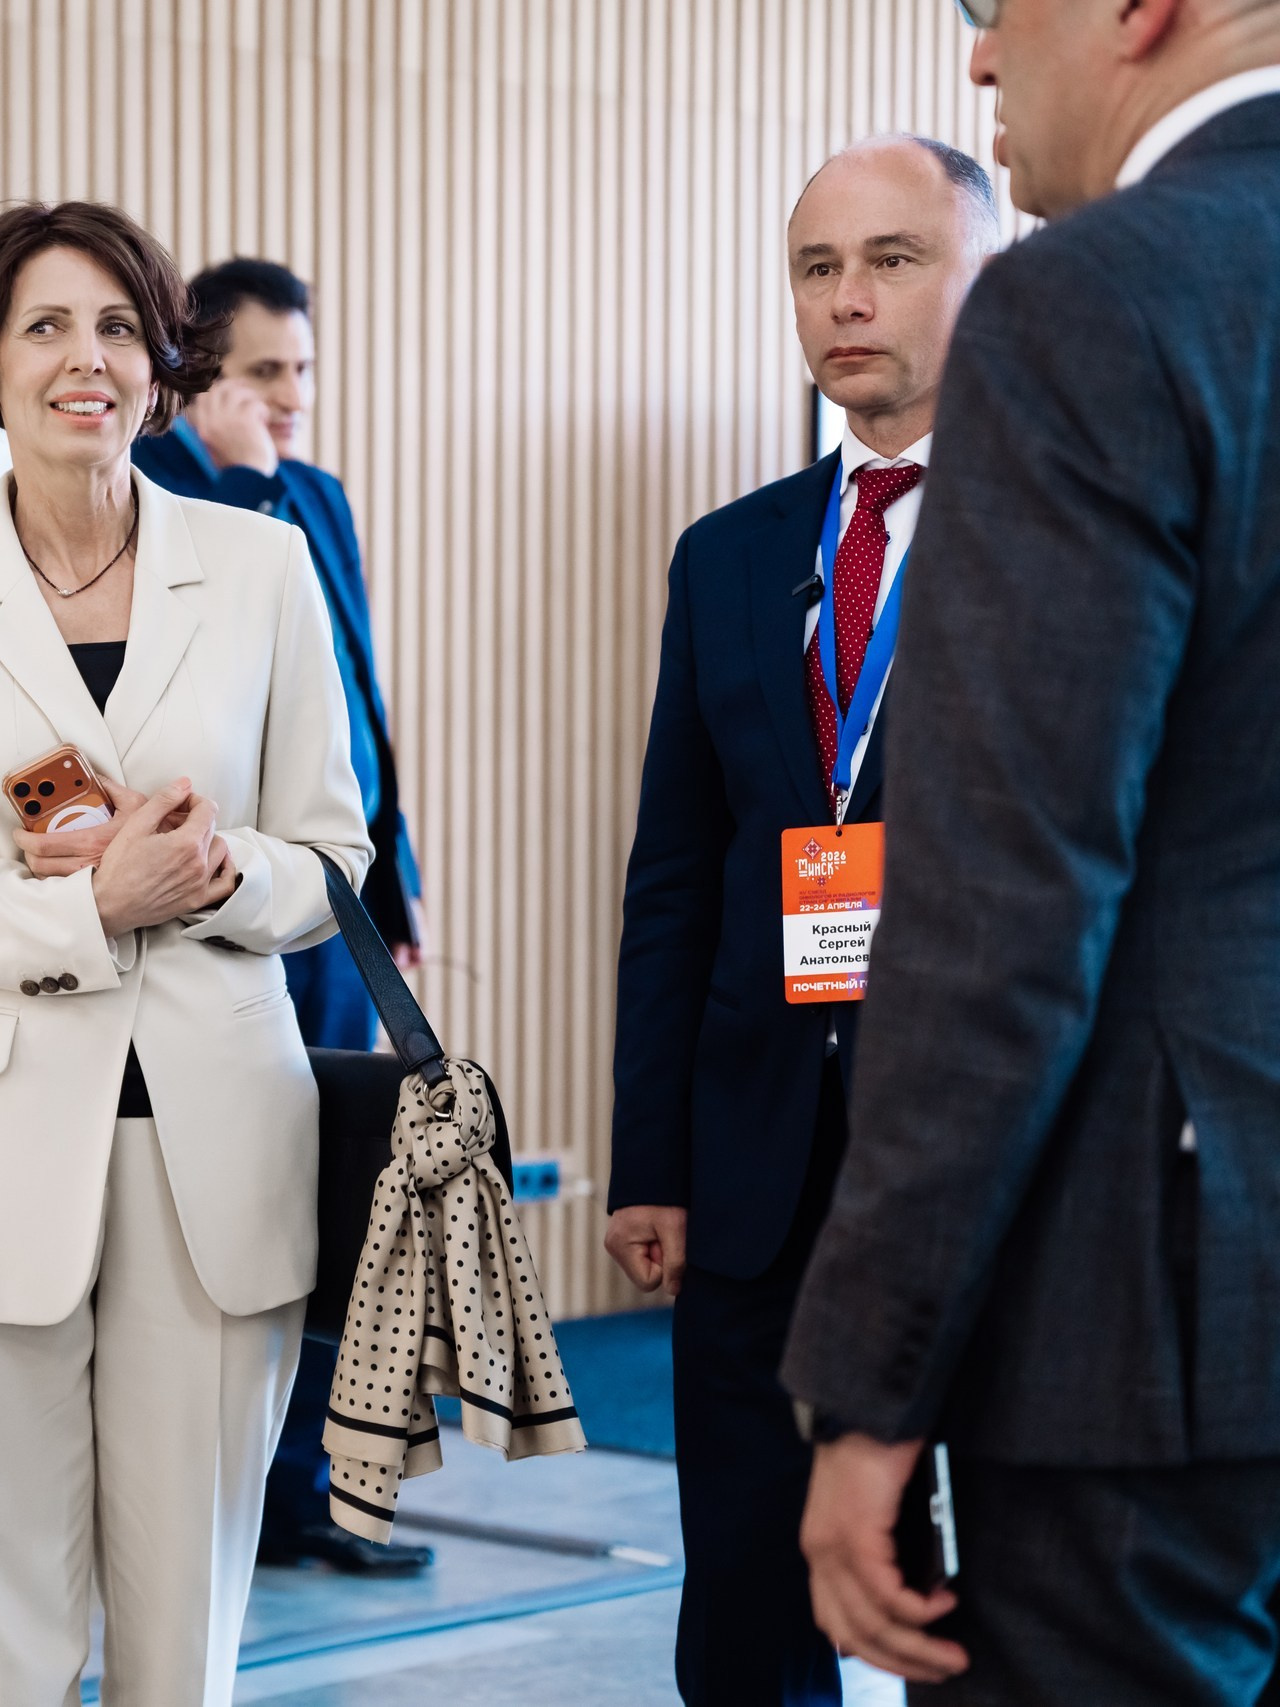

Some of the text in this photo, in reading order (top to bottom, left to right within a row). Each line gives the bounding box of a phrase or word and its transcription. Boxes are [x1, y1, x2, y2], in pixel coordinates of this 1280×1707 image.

[821, 851, 846, 862] 2026
[827, 901, 863, 910] АПРЕЛЯ
[812, 921, 871, 936] Красный
[819, 936, 865, 950] Сергей
[793, 978, 857, 992] ПОЧЕТНЫЙ
